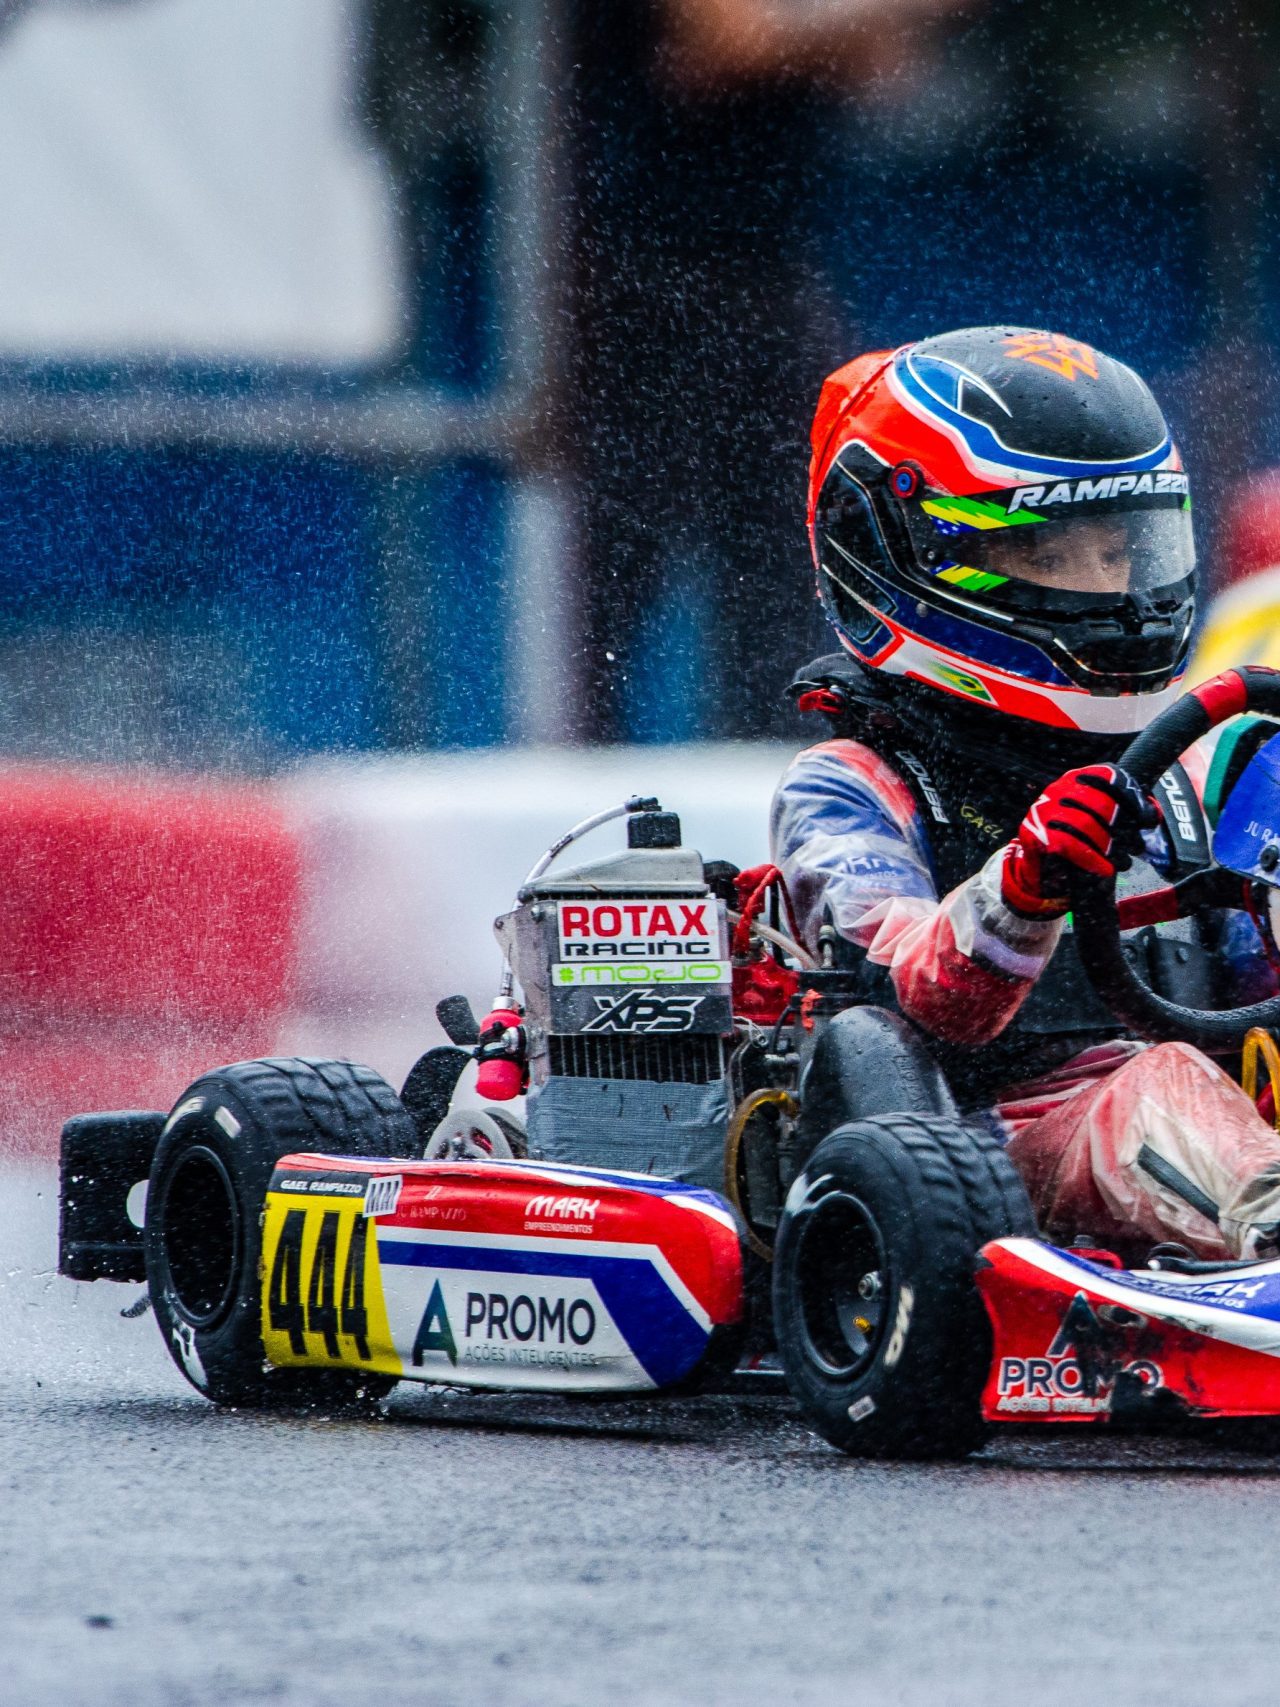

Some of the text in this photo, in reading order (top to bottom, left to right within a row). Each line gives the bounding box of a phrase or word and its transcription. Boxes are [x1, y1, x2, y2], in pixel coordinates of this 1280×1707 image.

[1159, 769, 1196, 842] BENG
[562, 904, 709, 938] ROTAX
[565, 939, 711, 957] RACING
[580, 989, 706, 1032] XPS
[281, 1180, 308, 1191] GAEL
[524, 1195, 600, 1220] MARK
[269, 1207, 371, 1361] 444
[465, 1292, 597, 1346] PROMO
